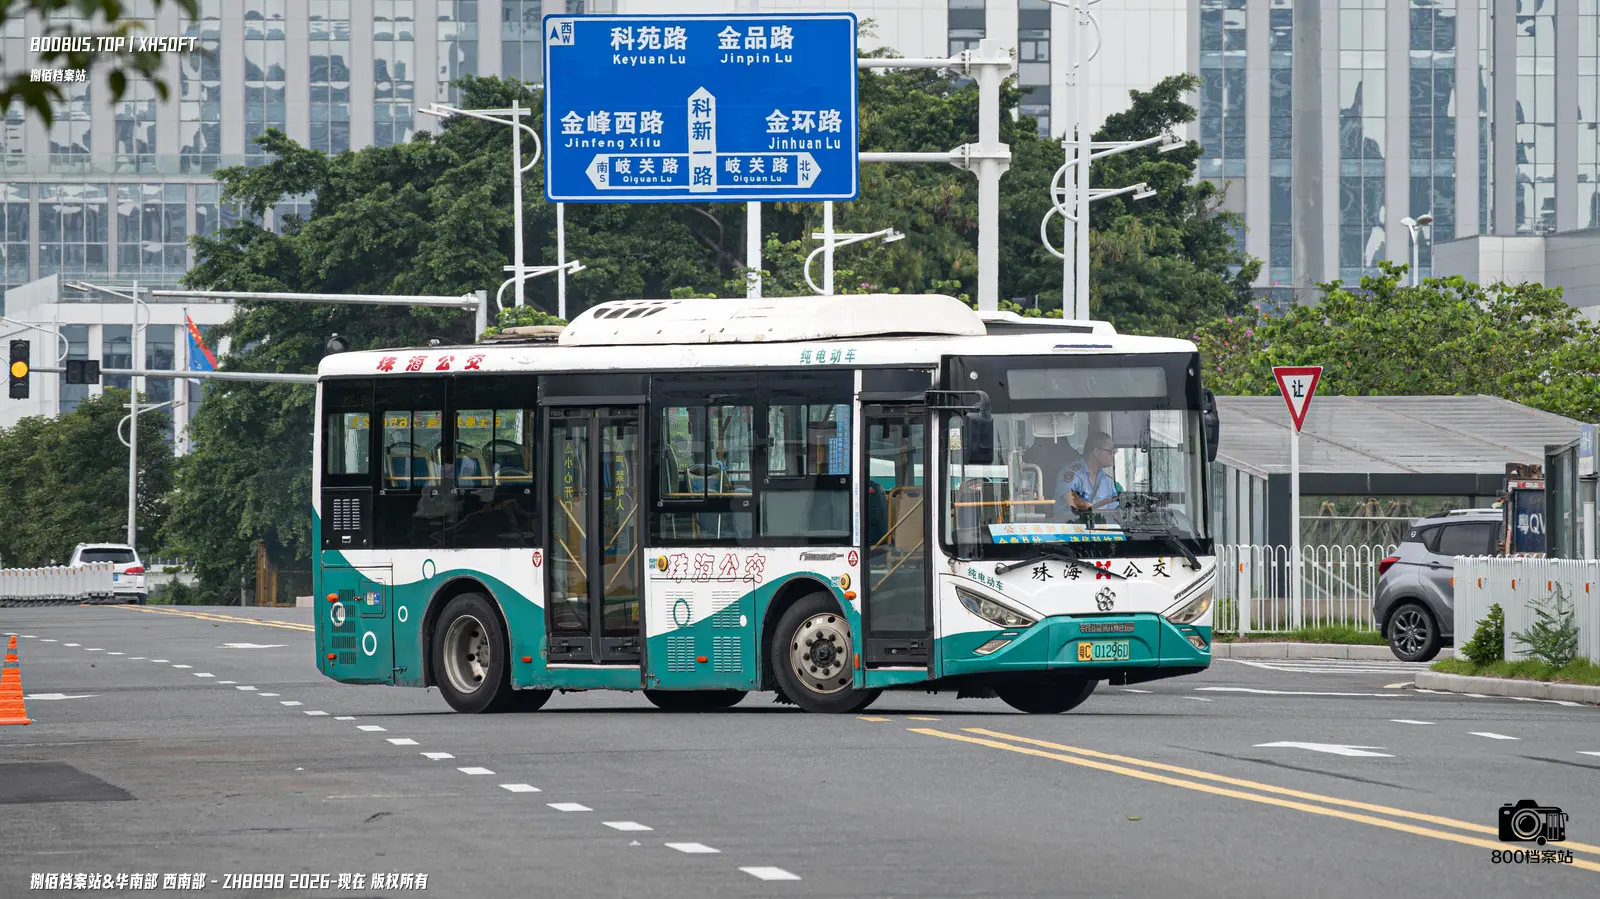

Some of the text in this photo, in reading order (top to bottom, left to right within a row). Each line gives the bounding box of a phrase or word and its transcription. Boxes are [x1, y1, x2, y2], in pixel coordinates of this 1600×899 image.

[560, 22, 573, 33] 西
[561, 33, 571, 44] W
[610, 26, 688, 51] 科苑路
[717, 25, 795, 50] 金品路
[612, 54, 686, 66] Keyuan Lu
[720, 53, 793, 66] Jinpin Lu
[560, 110, 665, 135] 金峰西路
[765, 108, 843, 134] 金环路
[565, 137, 661, 150] Jinfeng Xilu
[691, 98, 713, 187] 科新一路
[768, 137, 841, 150] Jinhuan Lu
[596, 161, 608, 174] 南
[615, 157, 679, 174] 岐关路
[725, 157, 789, 174] 岐关路
[799, 160, 811, 172] 北
[599, 174, 606, 183] S
[622, 175, 672, 185] Qiguan Lu
[733, 174, 782, 184] Qiguan Lu
[802, 173, 809, 181] N
[376, 354, 487, 373] 珠海公交
[799, 348, 858, 364] 纯电动车
[1292, 380, 1304, 398] 让
[666, 552, 766, 584] 珠海公交
[1032, 560, 1171, 582] 珠海 公交
[967, 566, 1004, 592] 纯电动车
